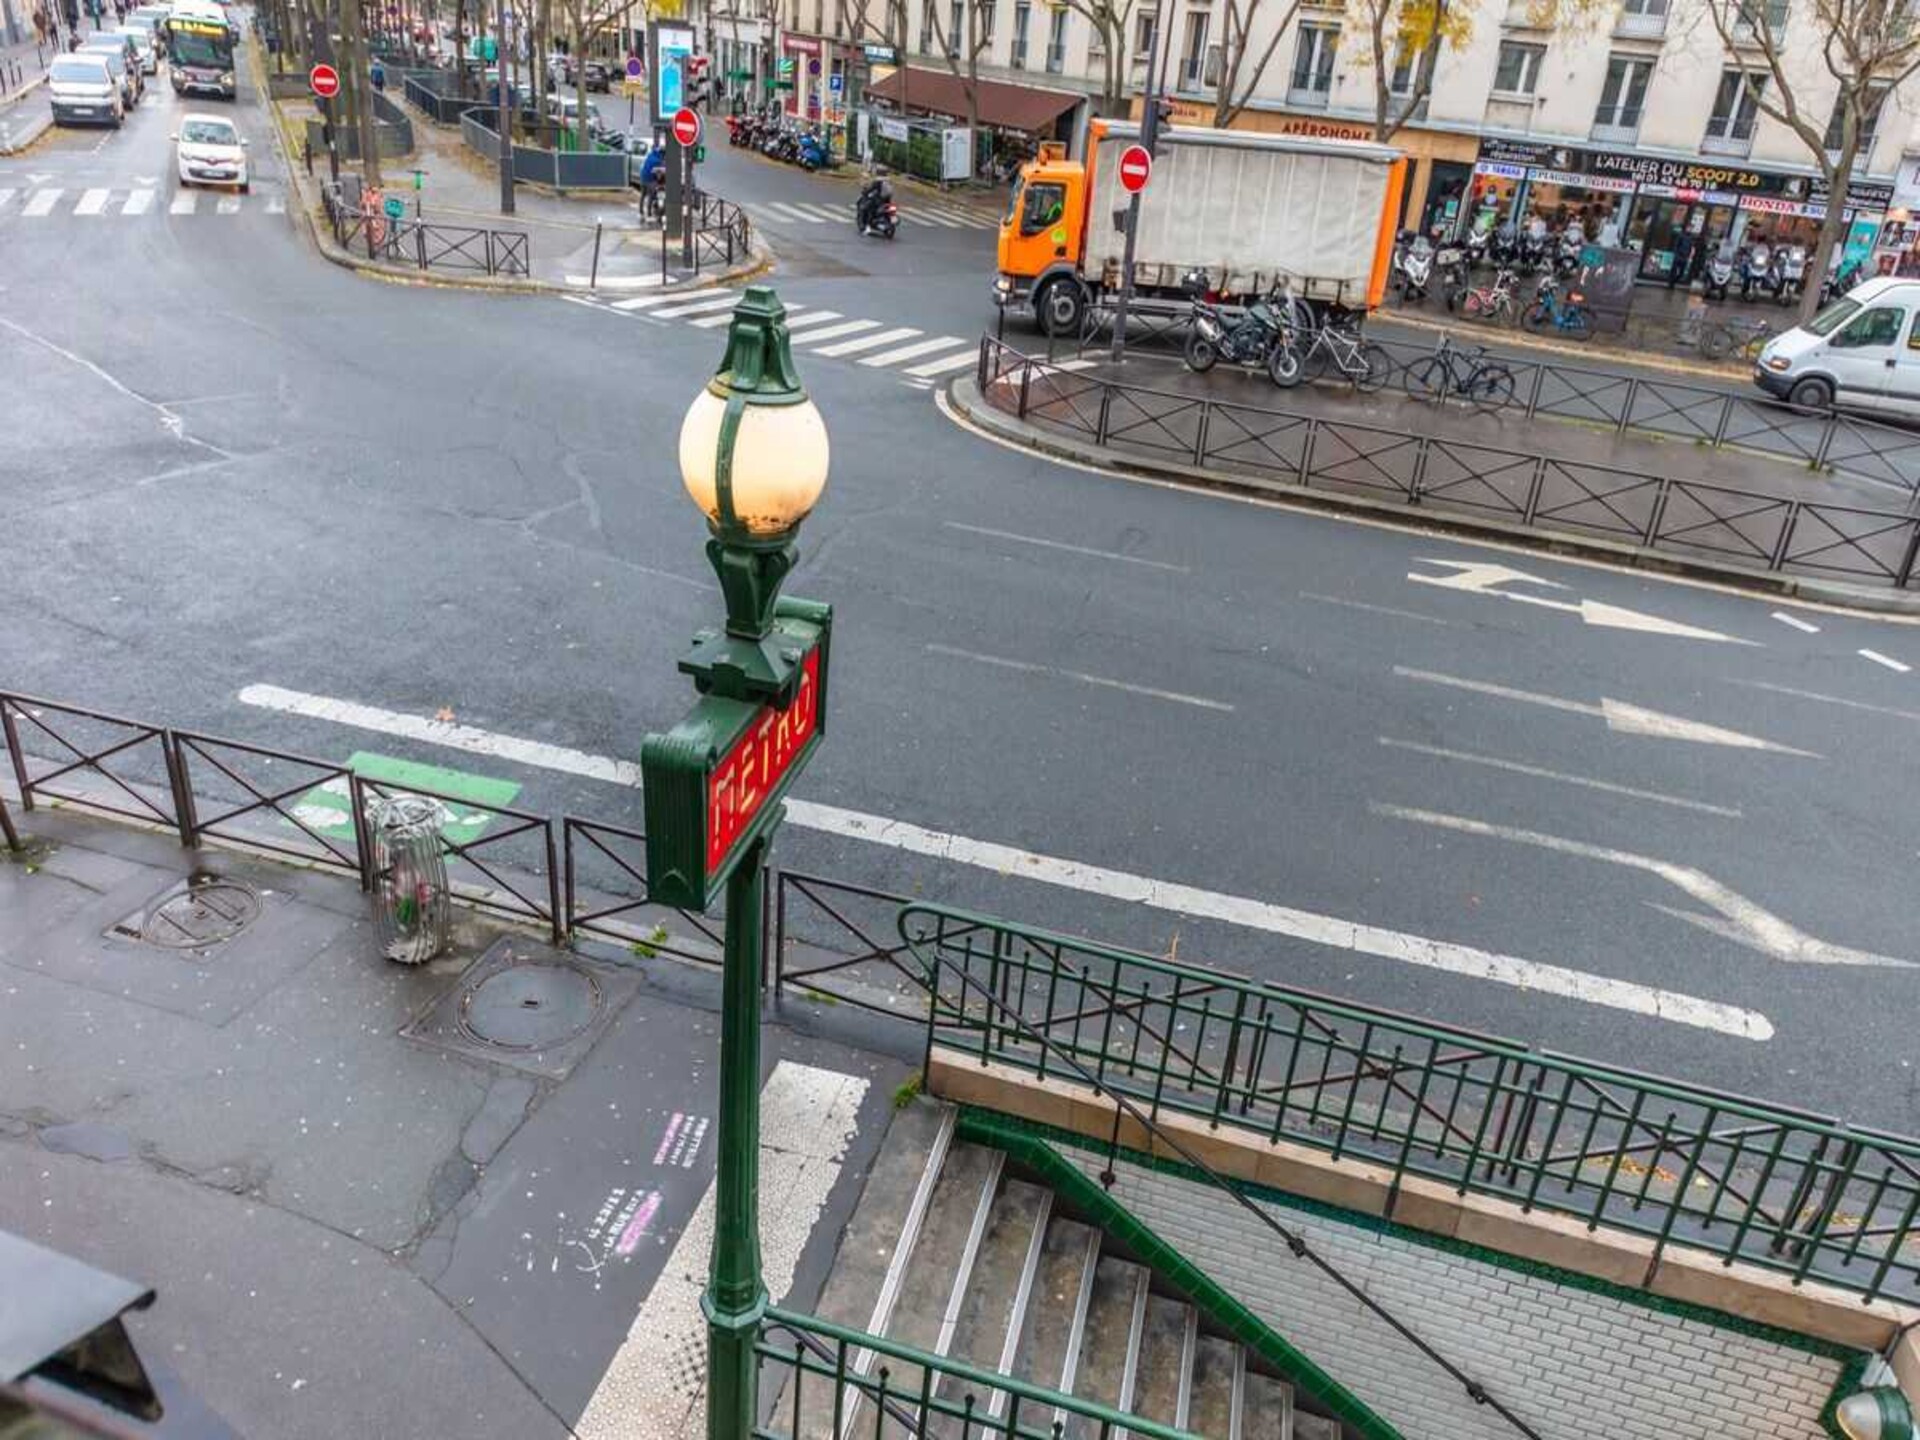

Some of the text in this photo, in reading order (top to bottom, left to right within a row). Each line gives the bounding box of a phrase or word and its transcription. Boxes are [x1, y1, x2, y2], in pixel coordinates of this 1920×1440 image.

[1595, 154, 1760, 187] L'ATELIER DU SCOOT 2.0
[1740, 196, 1797, 212] HONDA
